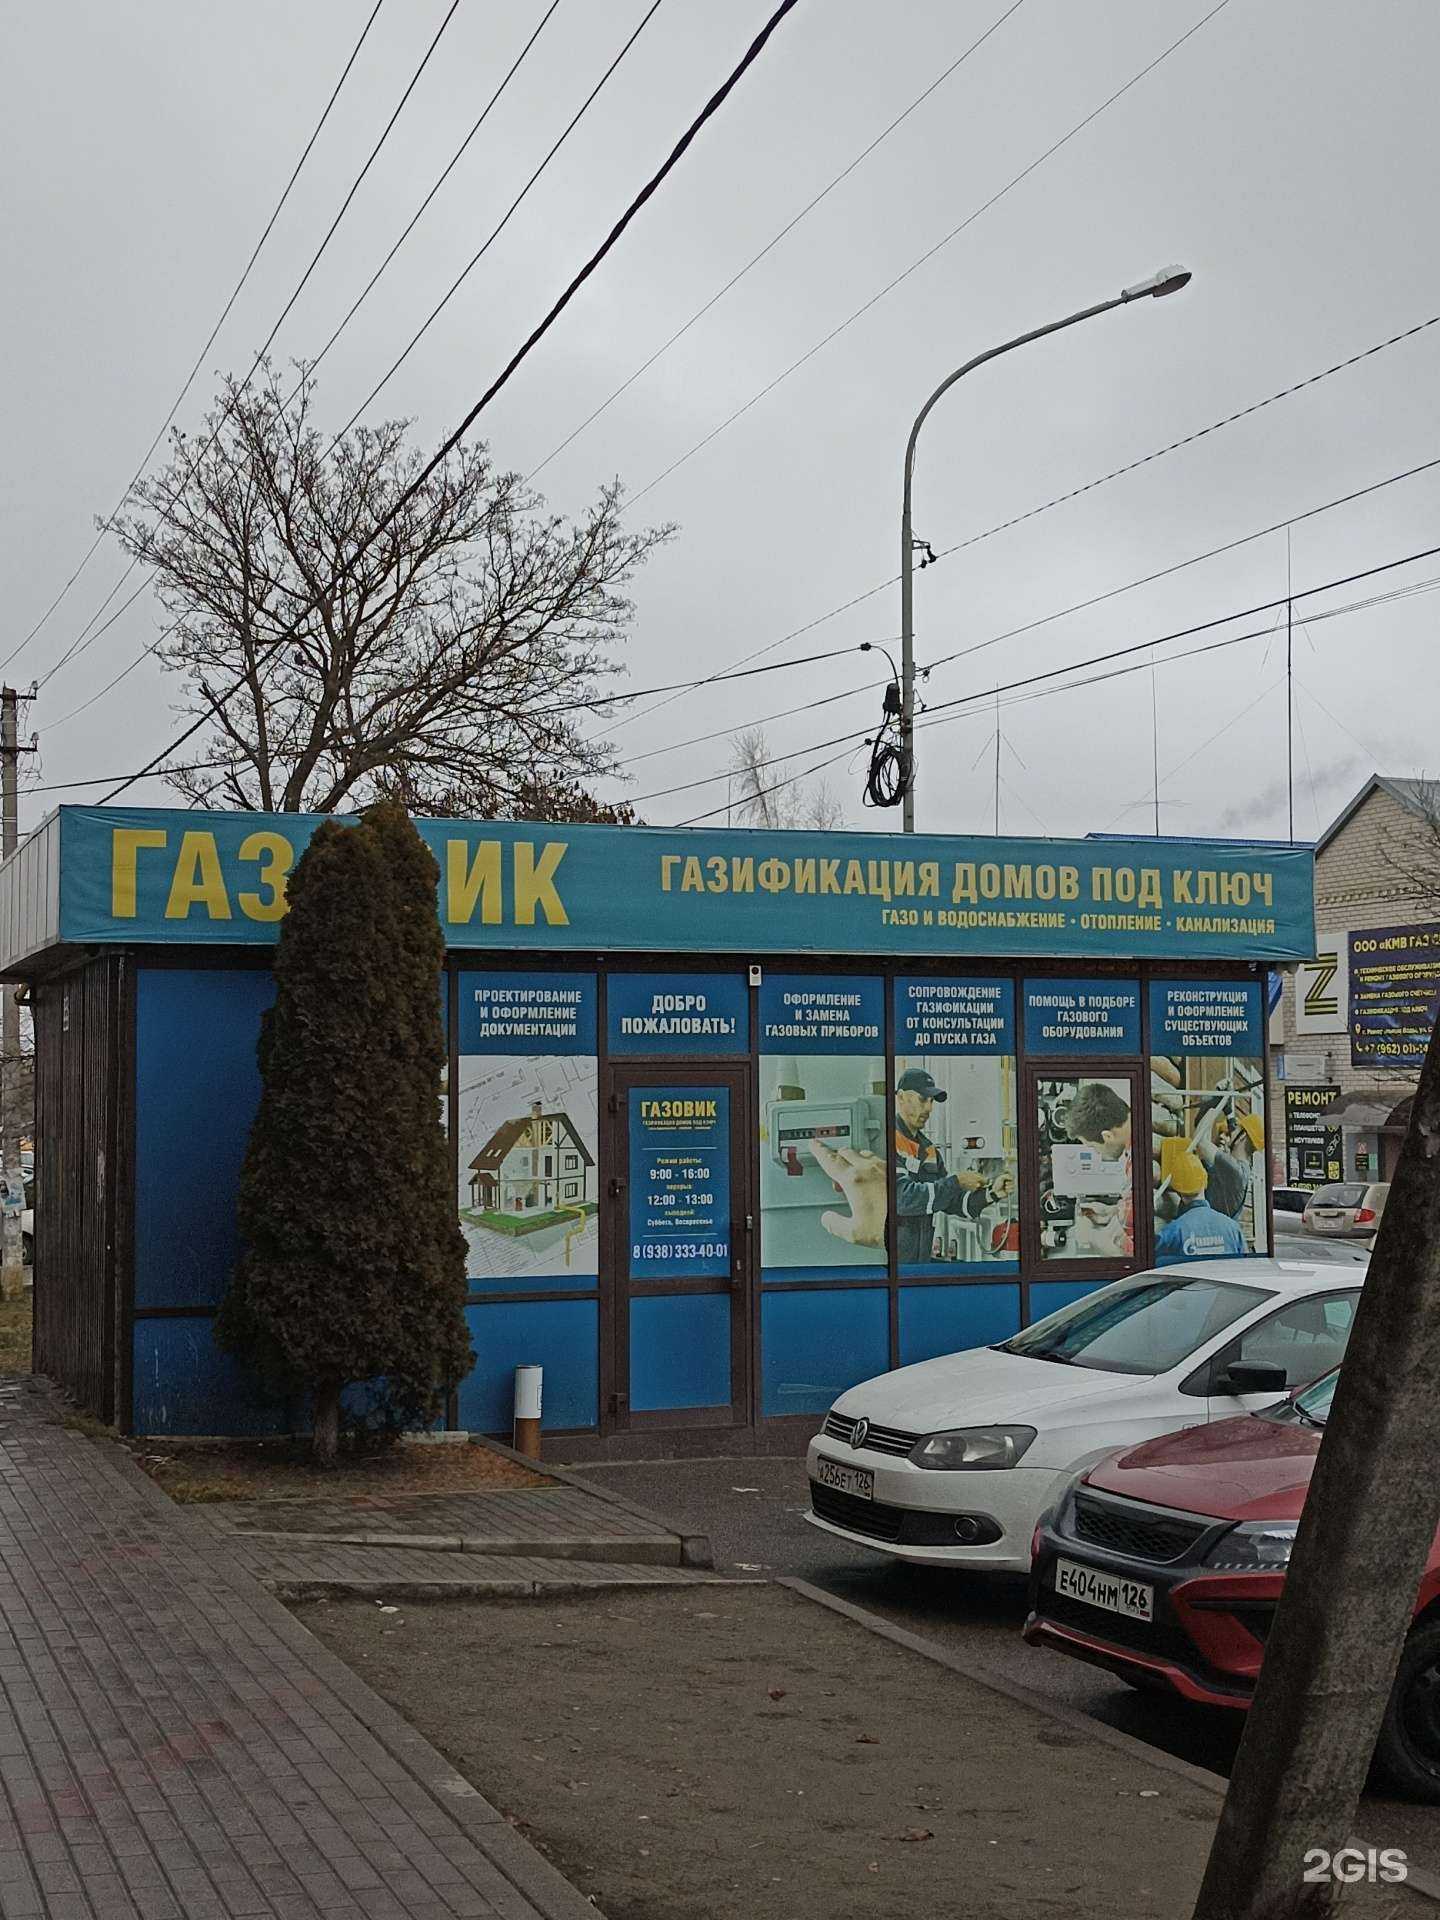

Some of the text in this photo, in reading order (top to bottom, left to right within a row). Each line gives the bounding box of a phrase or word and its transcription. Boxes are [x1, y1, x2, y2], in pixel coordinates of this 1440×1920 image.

[112, 828, 570, 926] ГАЗИК
[661, 855, 1273, 909] ГАЗИФИКАЦИЯ ДОМОВ ПОД КЛЮЧ
[882, 909, 1275, 936] ГАЗО И ВОДОСНАБЖЕНИЕ ОТОПЛЕНИЕ КАНАЛИЗАЦИЯ
[1353, 939, 1377, 953] ООО
[474, 990, 582, 1003] ПРОЕКТИРОВАНИЕ
[783, 993, 861, 1006] ОФОРМЛЕНИЕ
[908, 986, 1001, 1000] СОПРОВОЖДЕНИЕ
[1167, 990, 1248, 1004] РЕКОНСТРУКЦИЯ
[652, 995, 706, 1014] ДОБРО
[916, 1001, 994, 1015] ГАЗИФИКАЦИИ
[1029, 995, 1136, 1009] ПОМОЩЬ В ПОДБОРЕ
[480, 1007, 577, 1019] И ОФОРМЛЕНИЕ
[795, 1010, 850, 1021] И ЗАМЕНА
[1057, 1011, 1108, 1023] ГАЗОВОГО
[1168, 1005, 1245, 1018] И ОФОРМЛЕНИЕ
[480, 1023, 577, 1037] ДОКУМЕНТАЦИИ
[621, 1017, 736, 1034] ПОЖАЛОВАТЬ!
[766, 1024, 879, 1038] ГАЗОВЫХ ПРИБОРОВ
[907, 1017, 1004, 1031] ОТ КОНСУЛЬТАЦИИ
[1164, 1019, 1248, 1033] СУЩЕСТВУЮЩИХ
[915, 1032, 997, 1047] ДО ПУСКА ГАЗА
[1042, 1026, 1124, 1039] ОБОРУДОВАНИЯ
[1182, 1034, 1232, 1046] ОБЪЕКТОВ
[1287, 1091, 1337, 1105] РЕМОНТ
[641, 1101, 717, 1118] ГАЗОВИК
[650, 1168, 672, 1180] 9:00
[682, 1168, 710, 1180] 16:00
[647, 1195, 675, 1206] 12:00
[685, 1194, 713, 1205] 13:00
[633, 1243, 728, 1259] 8 (938) 333-40-01
[854, 1471, 870, 1489] 126
[1121, 1583, 1147, 1609] 126
